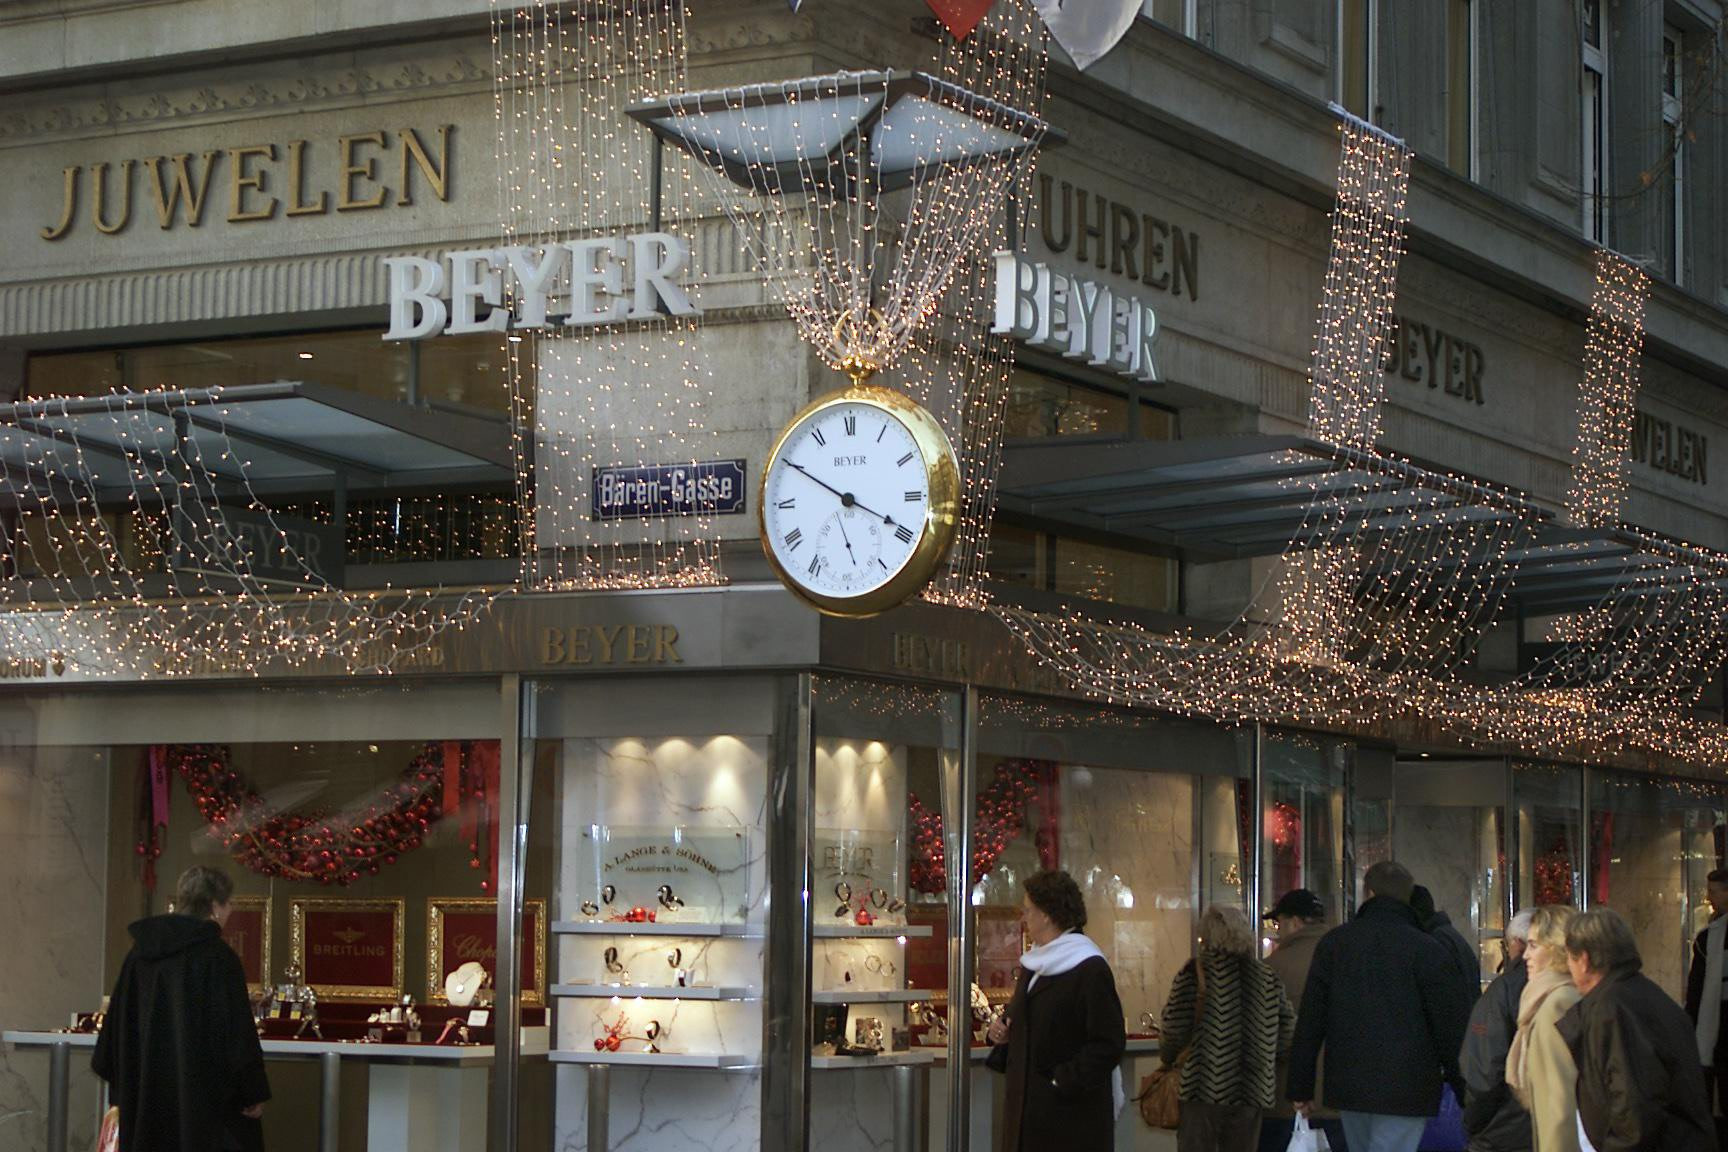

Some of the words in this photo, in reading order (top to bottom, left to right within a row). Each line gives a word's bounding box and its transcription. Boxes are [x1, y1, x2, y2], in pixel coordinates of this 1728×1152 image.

[39, 124, 455, 241] JUWELEN
[1039, 172, 1200, 302] UHREN
[382, 231, 702, 342] BEYER
[991, 249, 1165, 383] BEYER
[600, 469, 734, 506] Bären-Gasse
[833, 455, 867, 467] BEYER
[536, 623, 684, 665] BEYER
[313, 943, 386, 957] BREITLING
